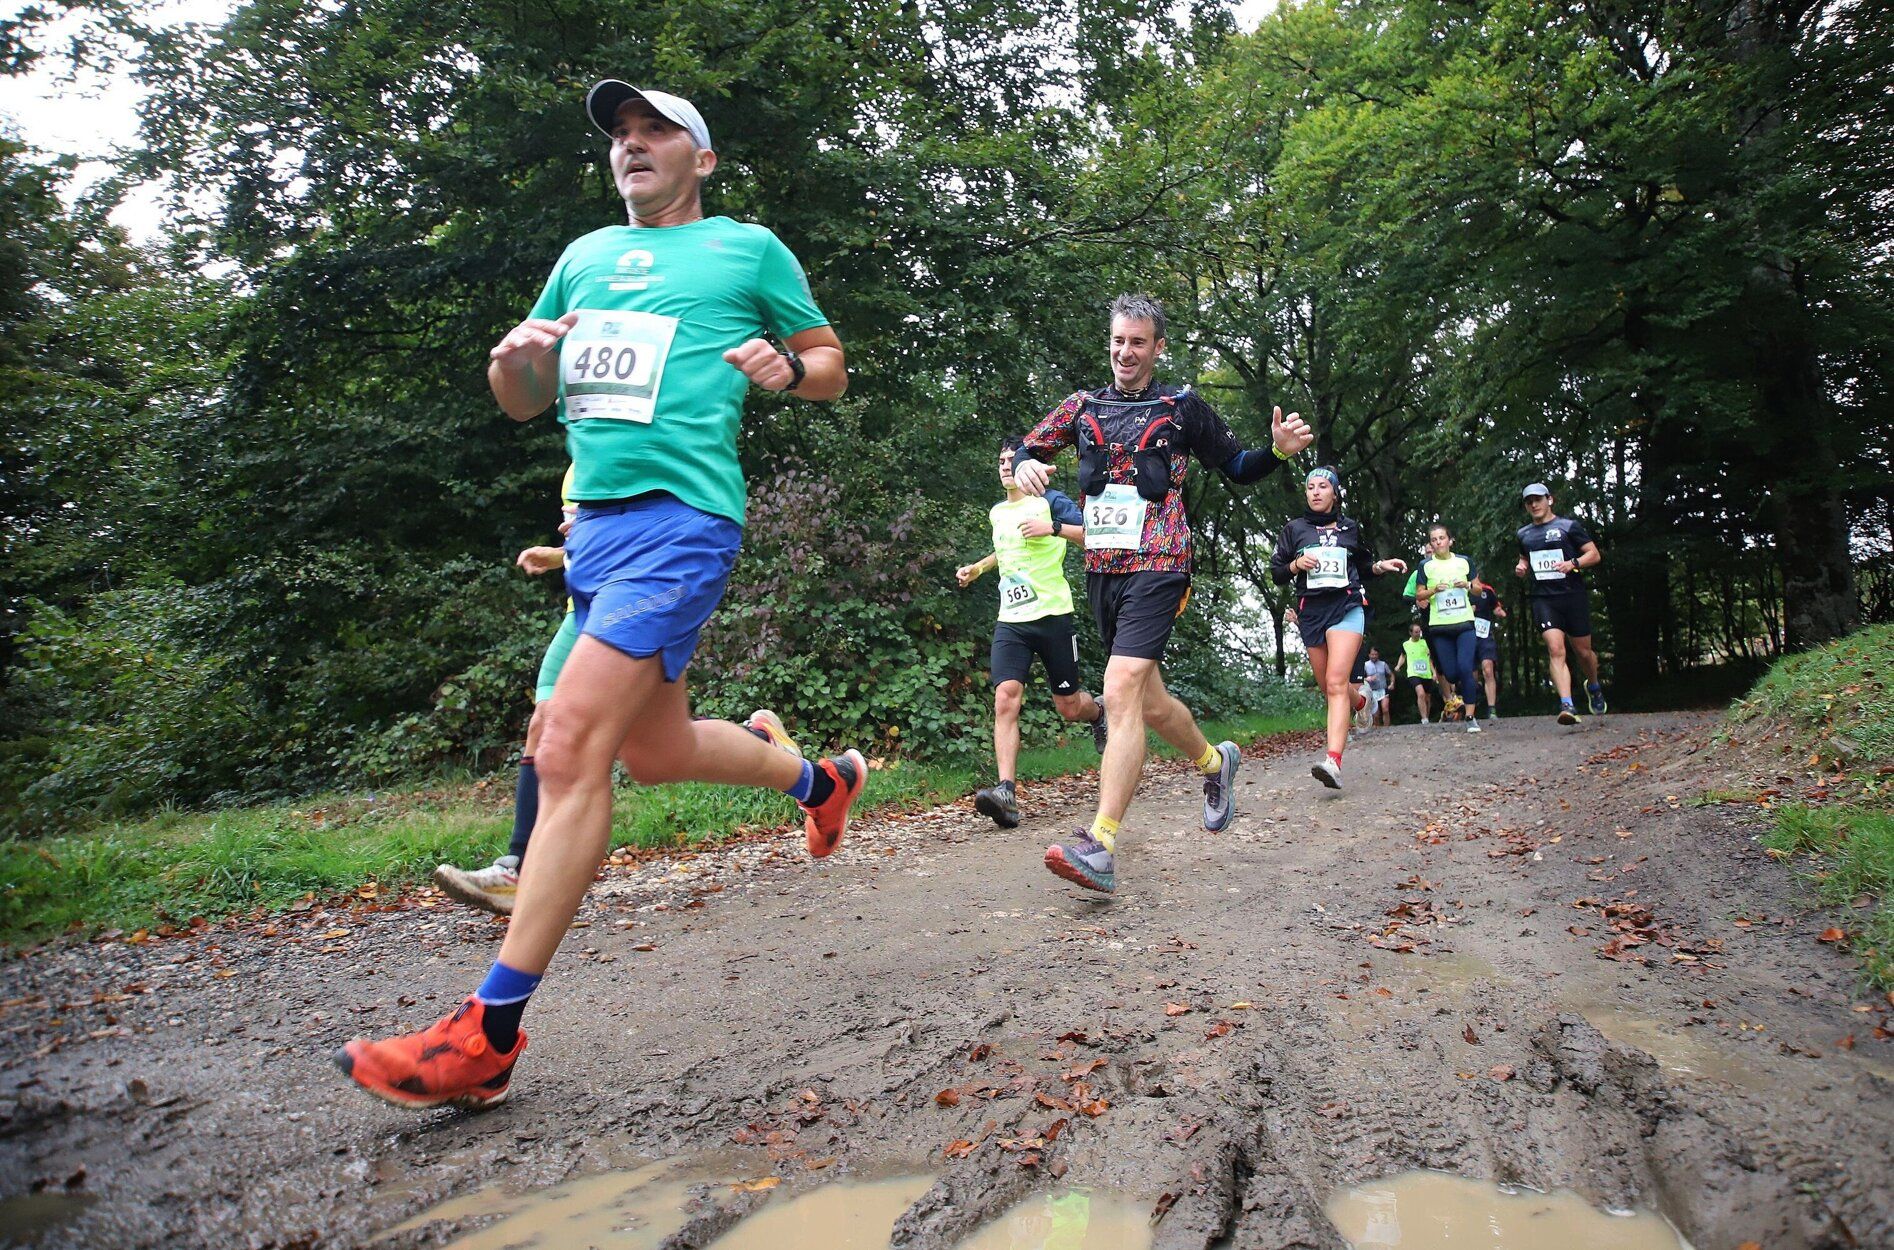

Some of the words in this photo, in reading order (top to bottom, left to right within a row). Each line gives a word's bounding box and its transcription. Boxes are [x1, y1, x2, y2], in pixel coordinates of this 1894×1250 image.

[573, 346, 637, 380] 480
[1092, 505, 1129, 526] 326
[1314, 560, 1340, 574] 923
[1006, 584, 1029, 603] 565
[1445, 598, 1458, 607] 84
